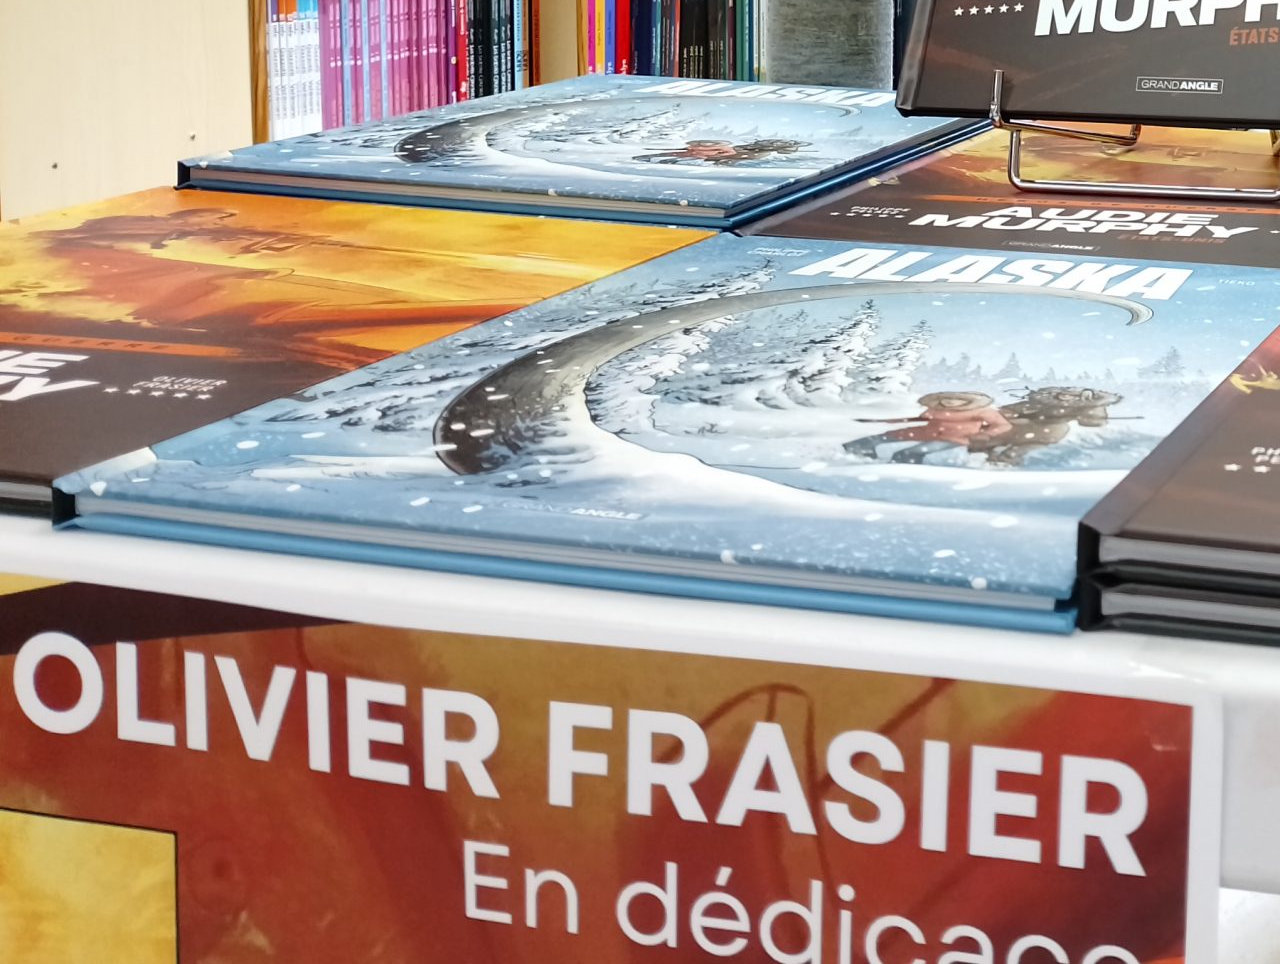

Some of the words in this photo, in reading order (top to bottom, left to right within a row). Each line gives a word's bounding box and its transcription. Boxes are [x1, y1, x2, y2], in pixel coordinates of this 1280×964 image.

[644, 79, 897, 108] ALASKA
[909, 213, 1259, 238] MURPHY
[981, 205, 1219, 226] AUDIE
[788, 247, 1194, 301] ALASKA
[132, 381, 215, 392] FRASIER
[152, 375, 228, 387] OLIVIER
[12, 630, 500, 802] OLIVIER
[548, 699, 1148, 878] FRASIER
[462, 839, 580, 935] En
